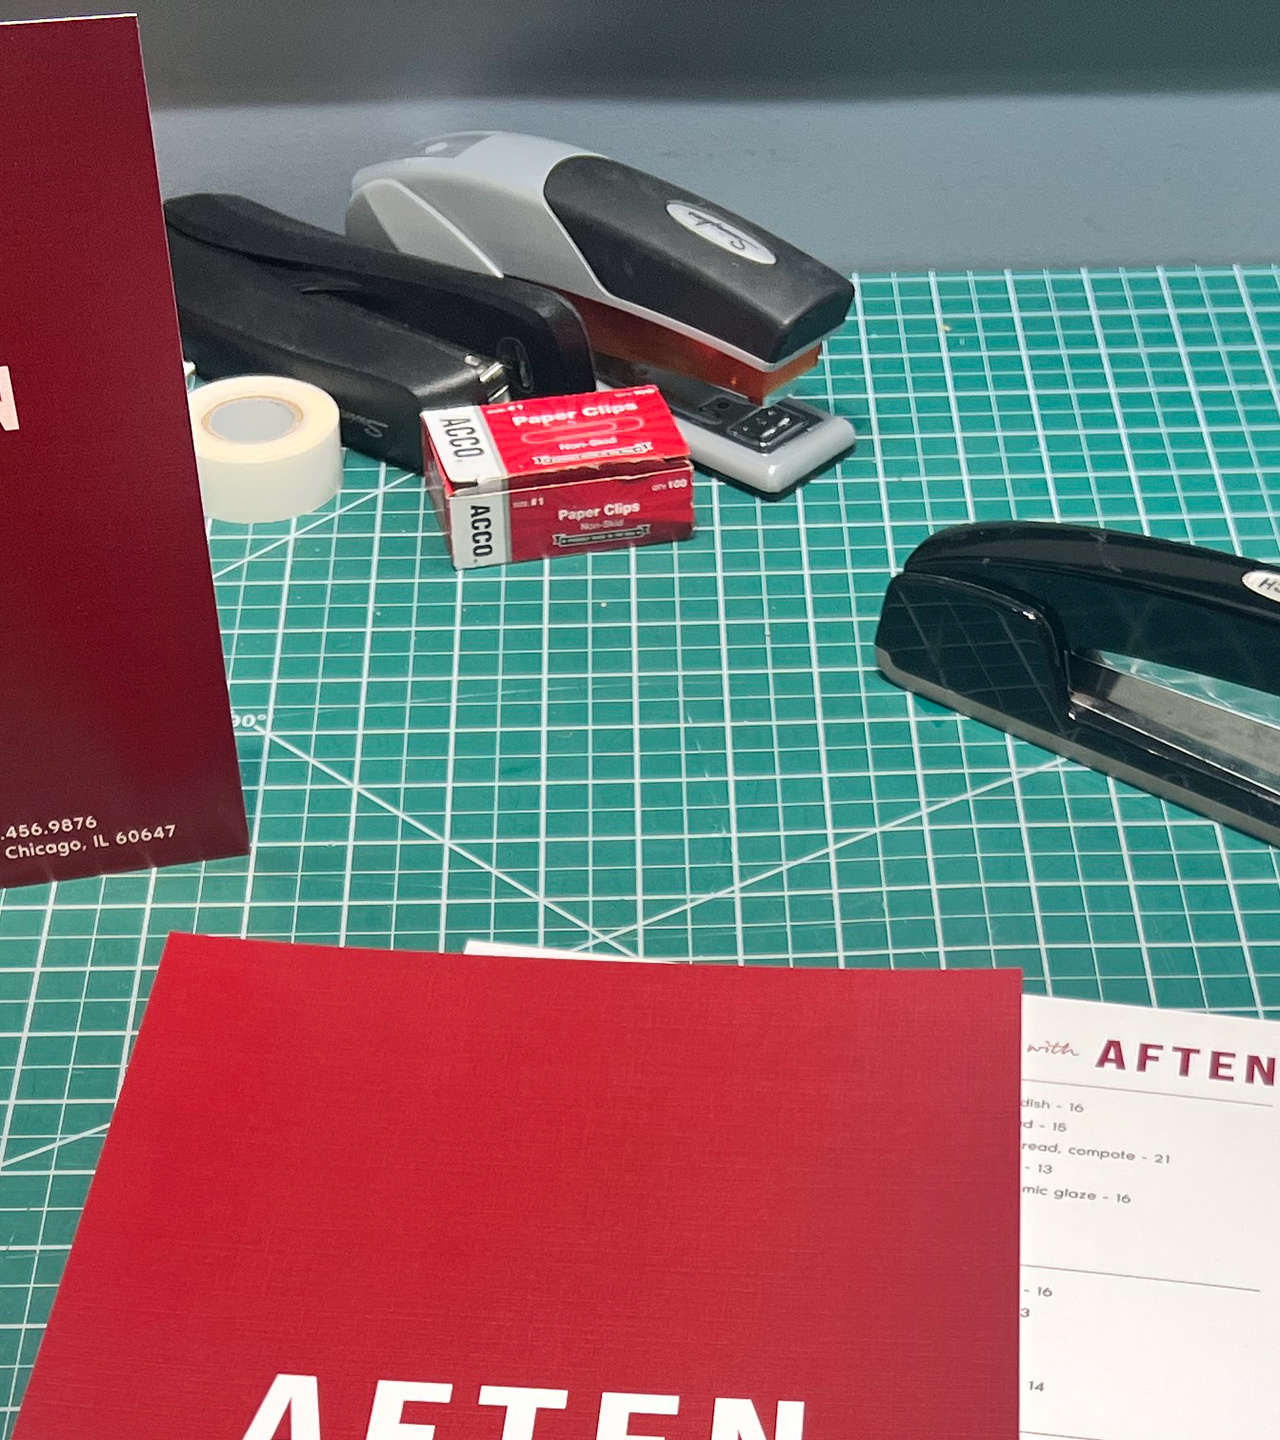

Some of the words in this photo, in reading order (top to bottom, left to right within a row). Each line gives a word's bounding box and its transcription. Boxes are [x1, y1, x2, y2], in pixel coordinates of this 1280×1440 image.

[512, 410, 577, 427] Paper
[582, 402, 638, 418] Clips
[440, 417, 484, 459] ACCO
[558, 507, 601, 522] Paper
[604, 503, 641, 516] Clips
[470, 505, 493, 558] ACCO
[6, 840, 86, 859] Chicago,
[93, 835, 109, 847] IL
[116, 825, 175, 844] 60647
[1027, 1040, 1079, 1056] with
[1095, 1040, 1276, 1086] AFTEN
[1068, 1147, 1135, 1161] compote
[1154, 1154, 1170, 1164] 21
[1054, 1188, 1096, 1200] glaze
[1116, 1193, 1131, 1204] 16
